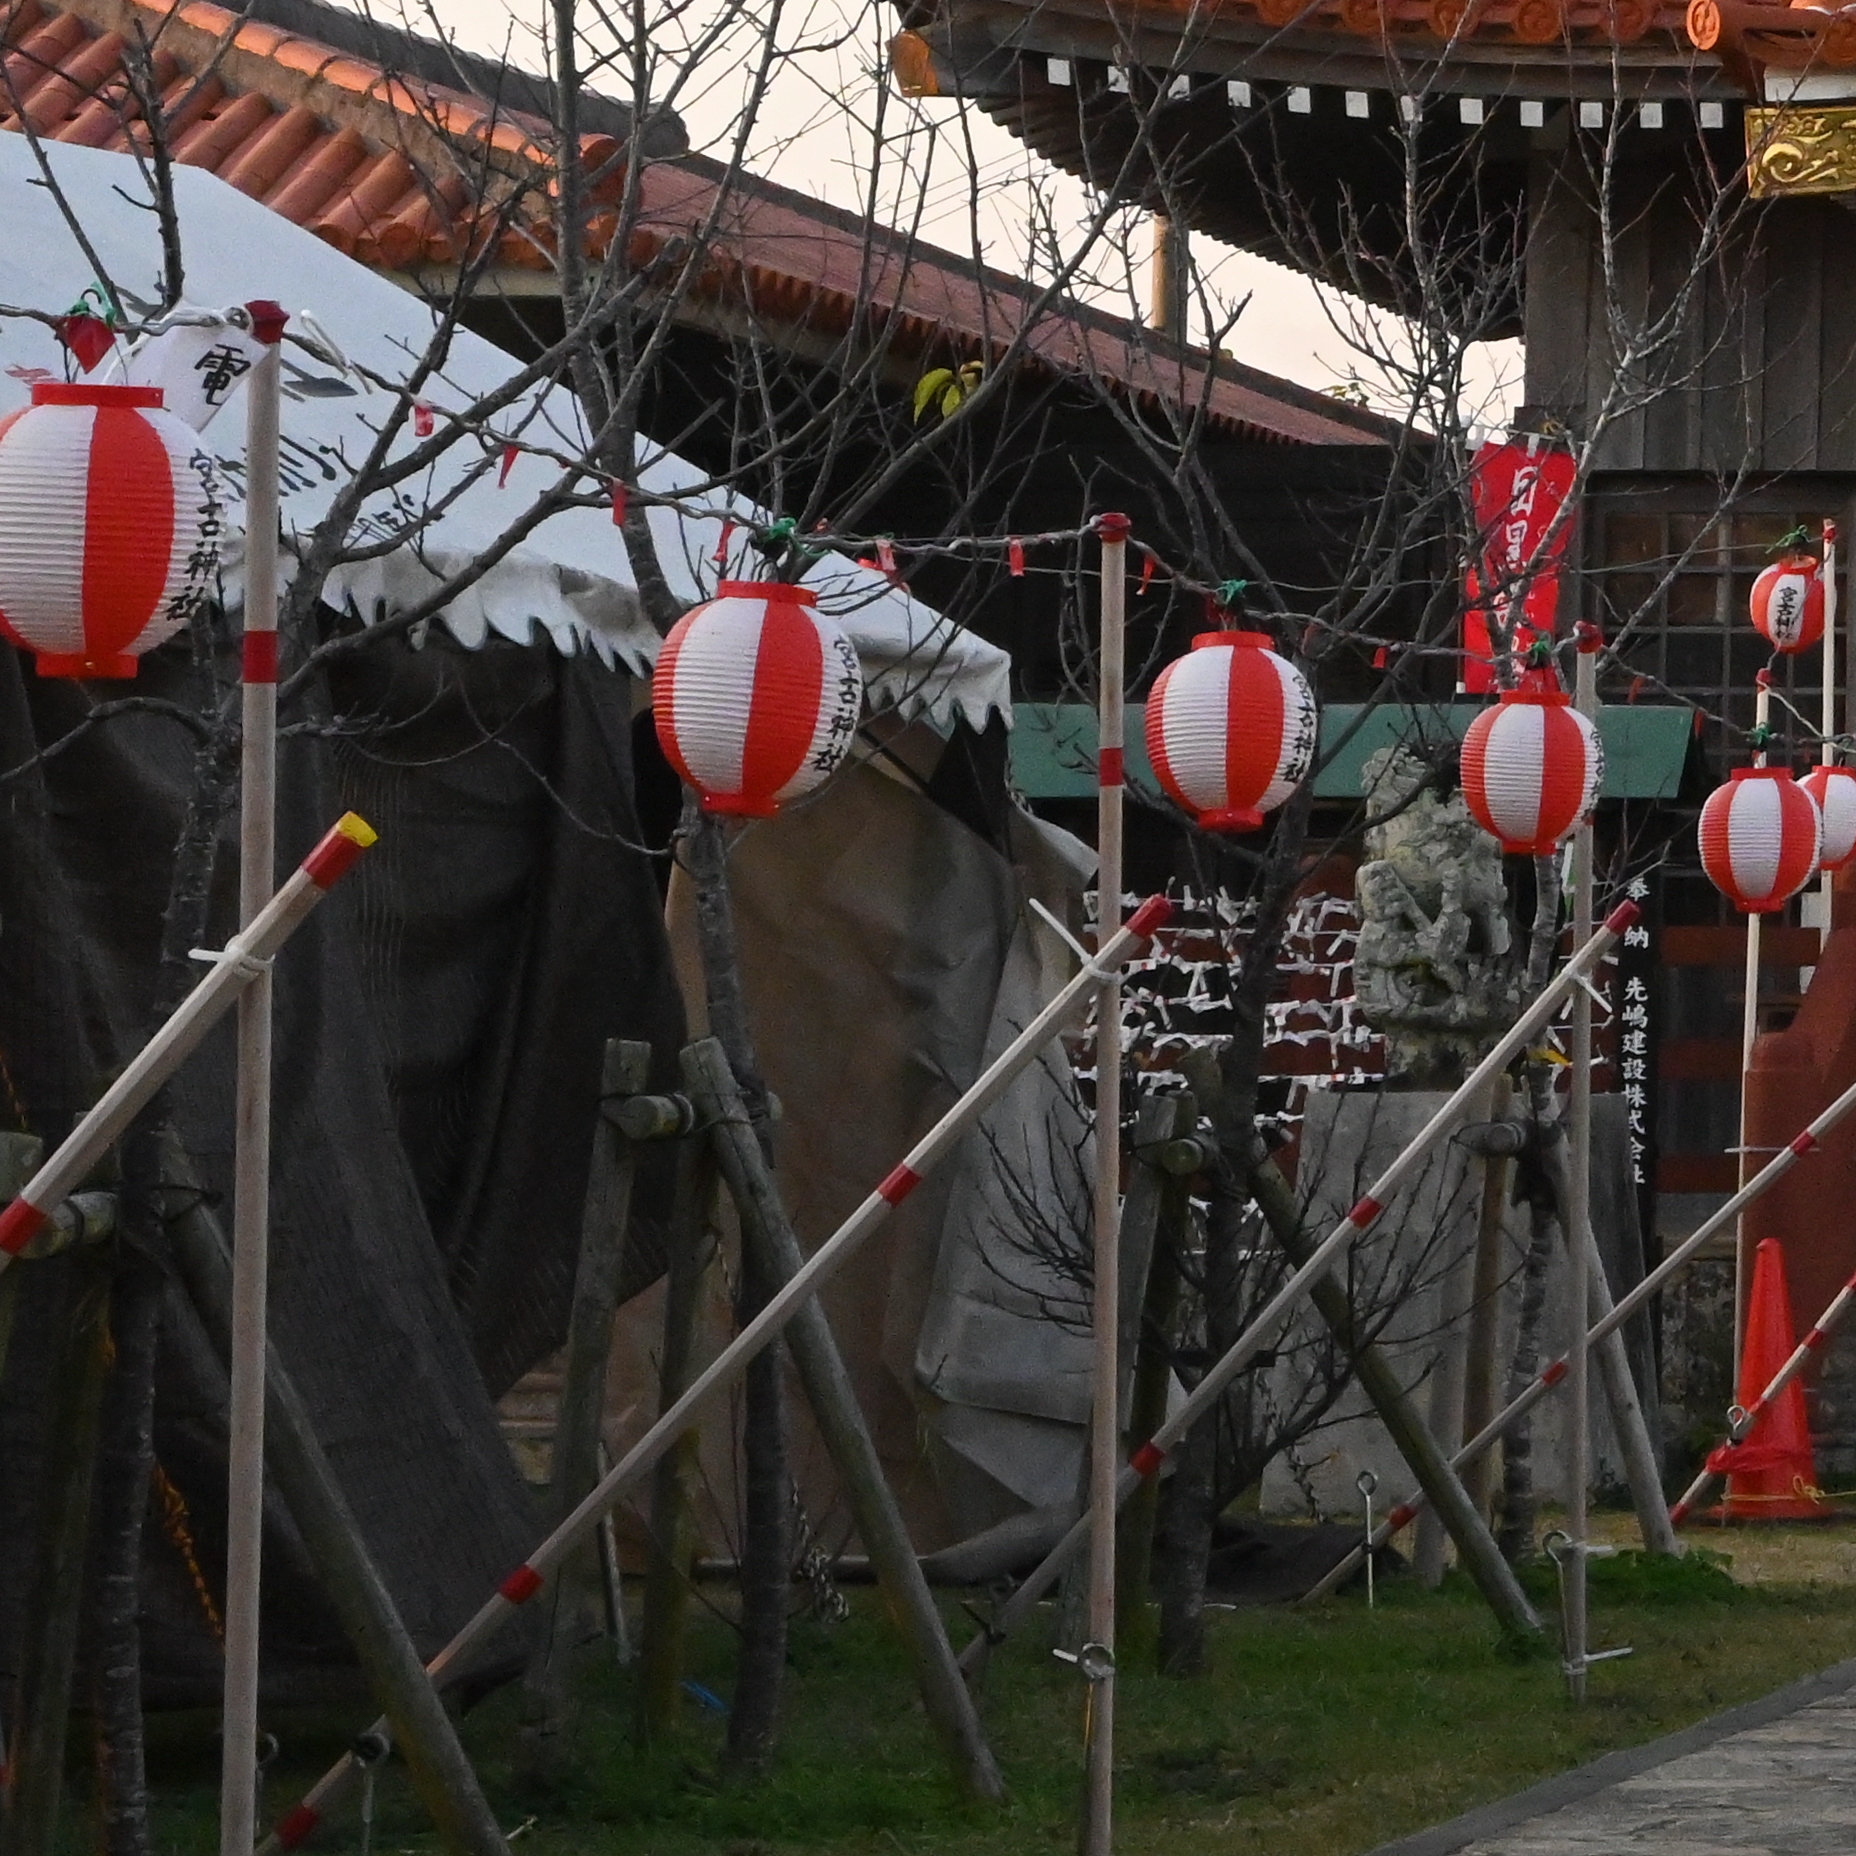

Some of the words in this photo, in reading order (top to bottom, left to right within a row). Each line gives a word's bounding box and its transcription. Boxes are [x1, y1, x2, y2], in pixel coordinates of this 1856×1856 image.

[194, 343, 252, 406] 電
[166, 447, 223, 622] 宮古神社
[1624, 877, 1651, 950] 奉納
